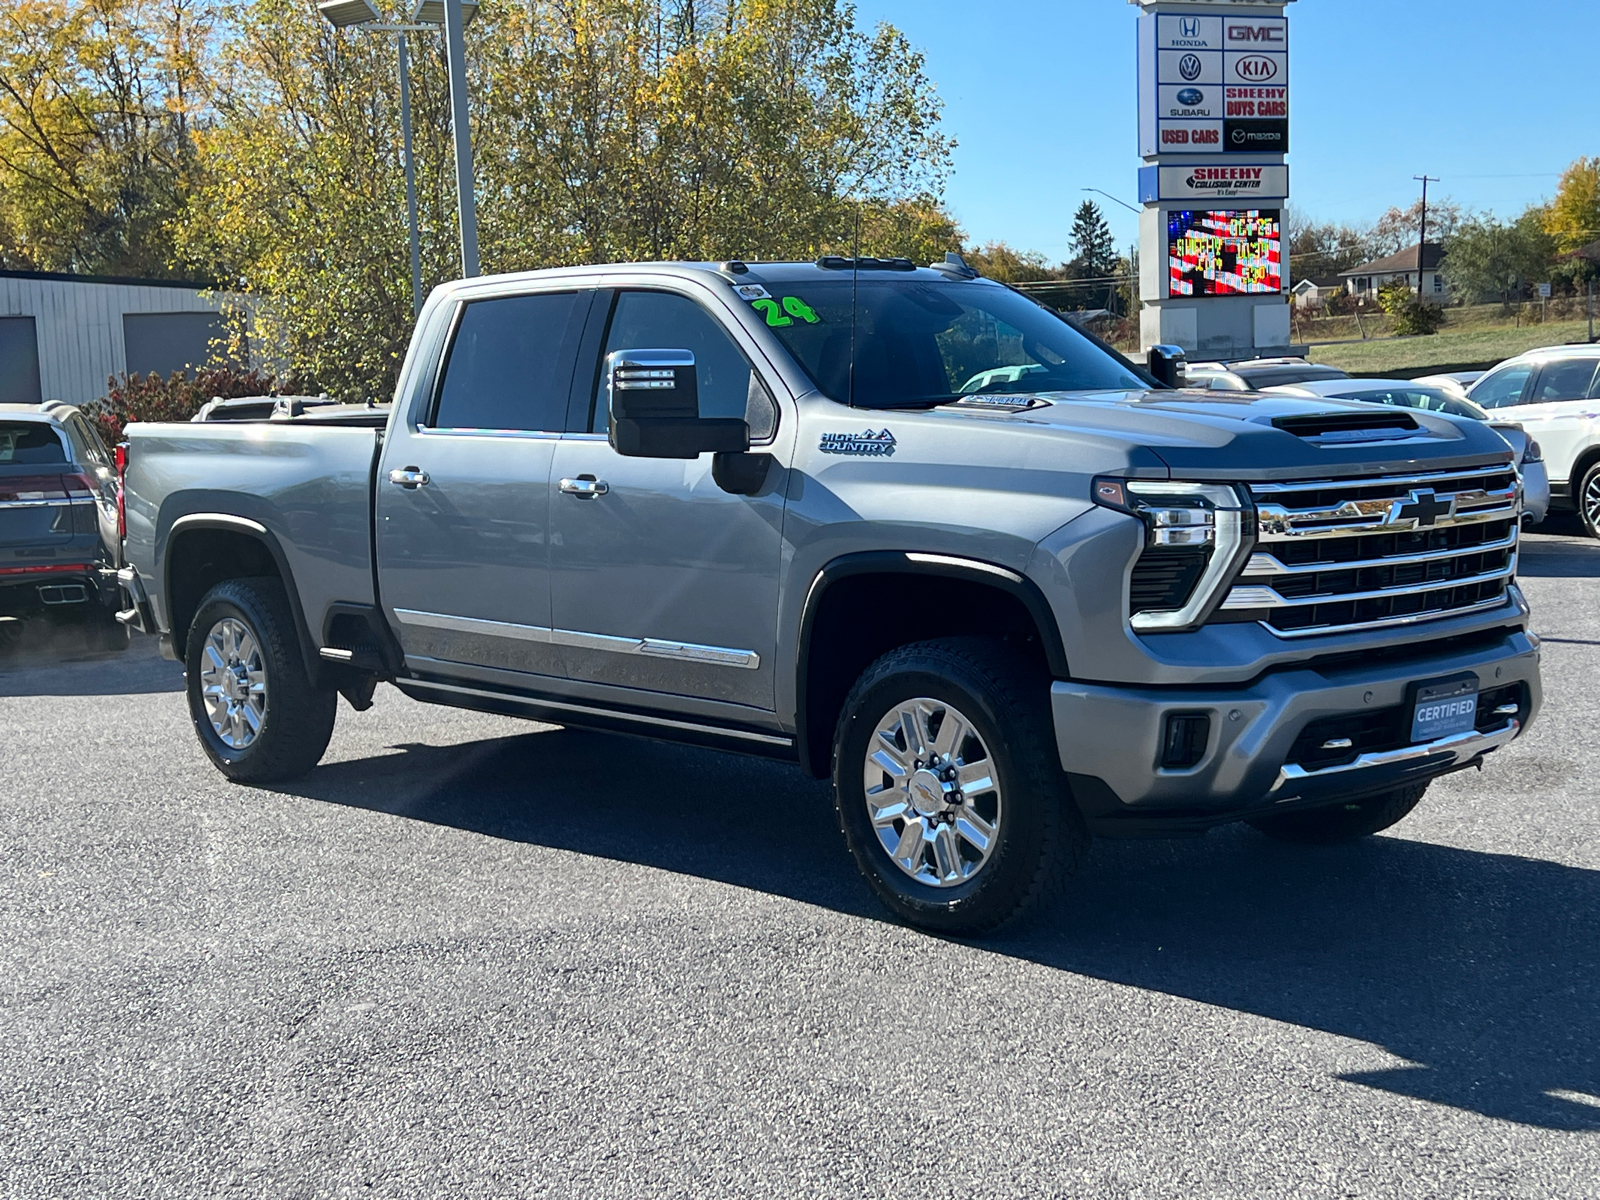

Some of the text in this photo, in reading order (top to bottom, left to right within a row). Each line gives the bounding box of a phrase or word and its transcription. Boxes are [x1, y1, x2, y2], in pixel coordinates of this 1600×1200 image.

[1228, 25, 1284, 42] GMC
[1242, 60, 1271, 76] KIA
[1226, 87, 1286, 99] SHEEHY
[1170, 109, 1211, 117] SUBARU
[1226, 101, 1286, 117] BUYS CARS
[1161, 129, 1219, 144] USED CARS
[1194, 168, 1262, 180] SHEEHY
[1194, 180, 1262, 189] COLLISION CENTER
[751, 296, 820, 326] 24
[820, 432, 857, 442] HIGH
[817, 440, 889, 453] COUNTRY
[1417, 700, 1474, 722] CERTIFIED
